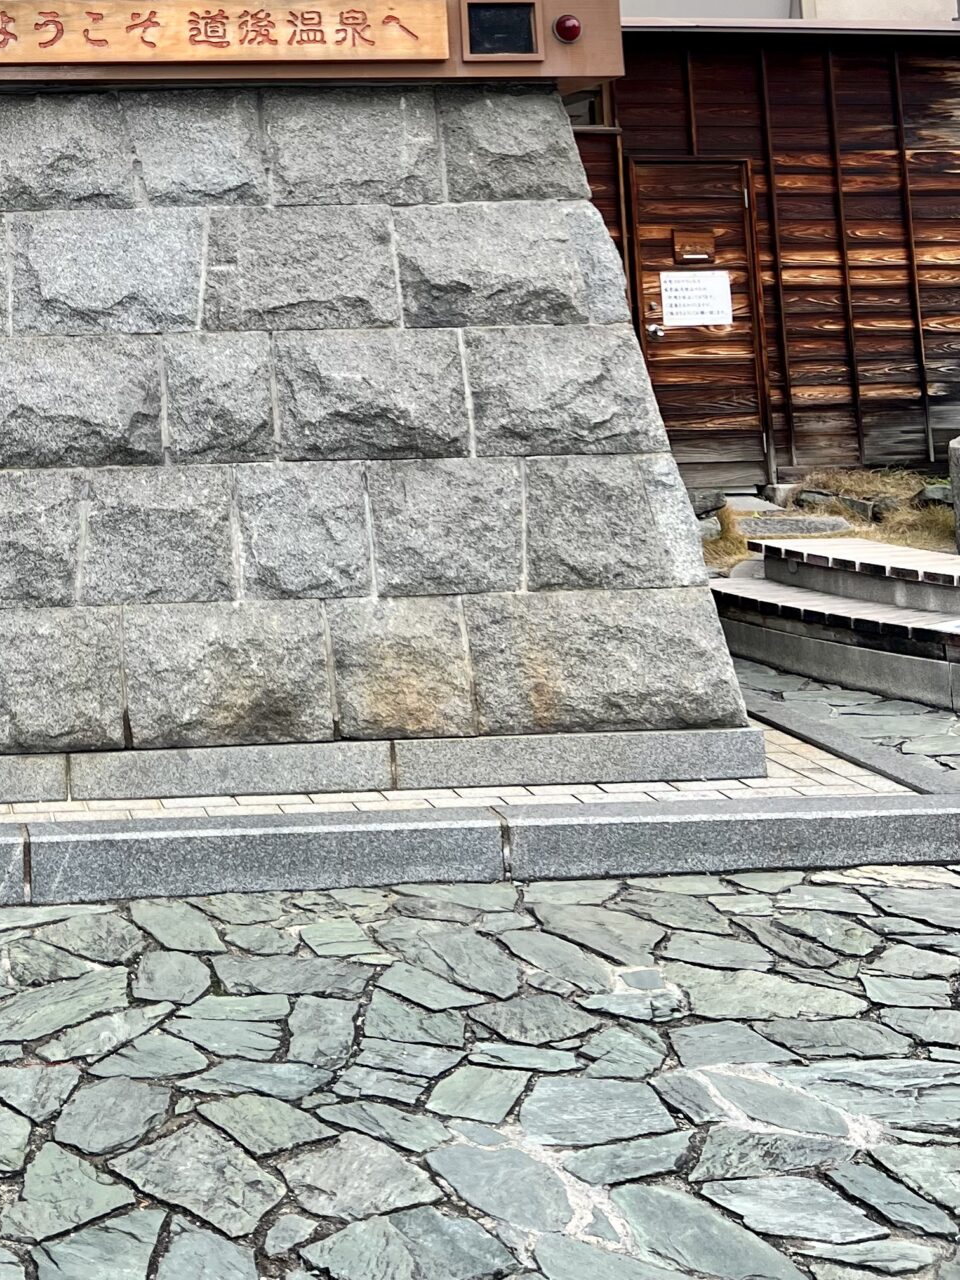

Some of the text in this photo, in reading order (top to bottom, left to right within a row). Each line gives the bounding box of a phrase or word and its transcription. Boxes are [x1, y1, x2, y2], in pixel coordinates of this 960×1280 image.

[188, 9, 420, 49] 道後温泉へ
